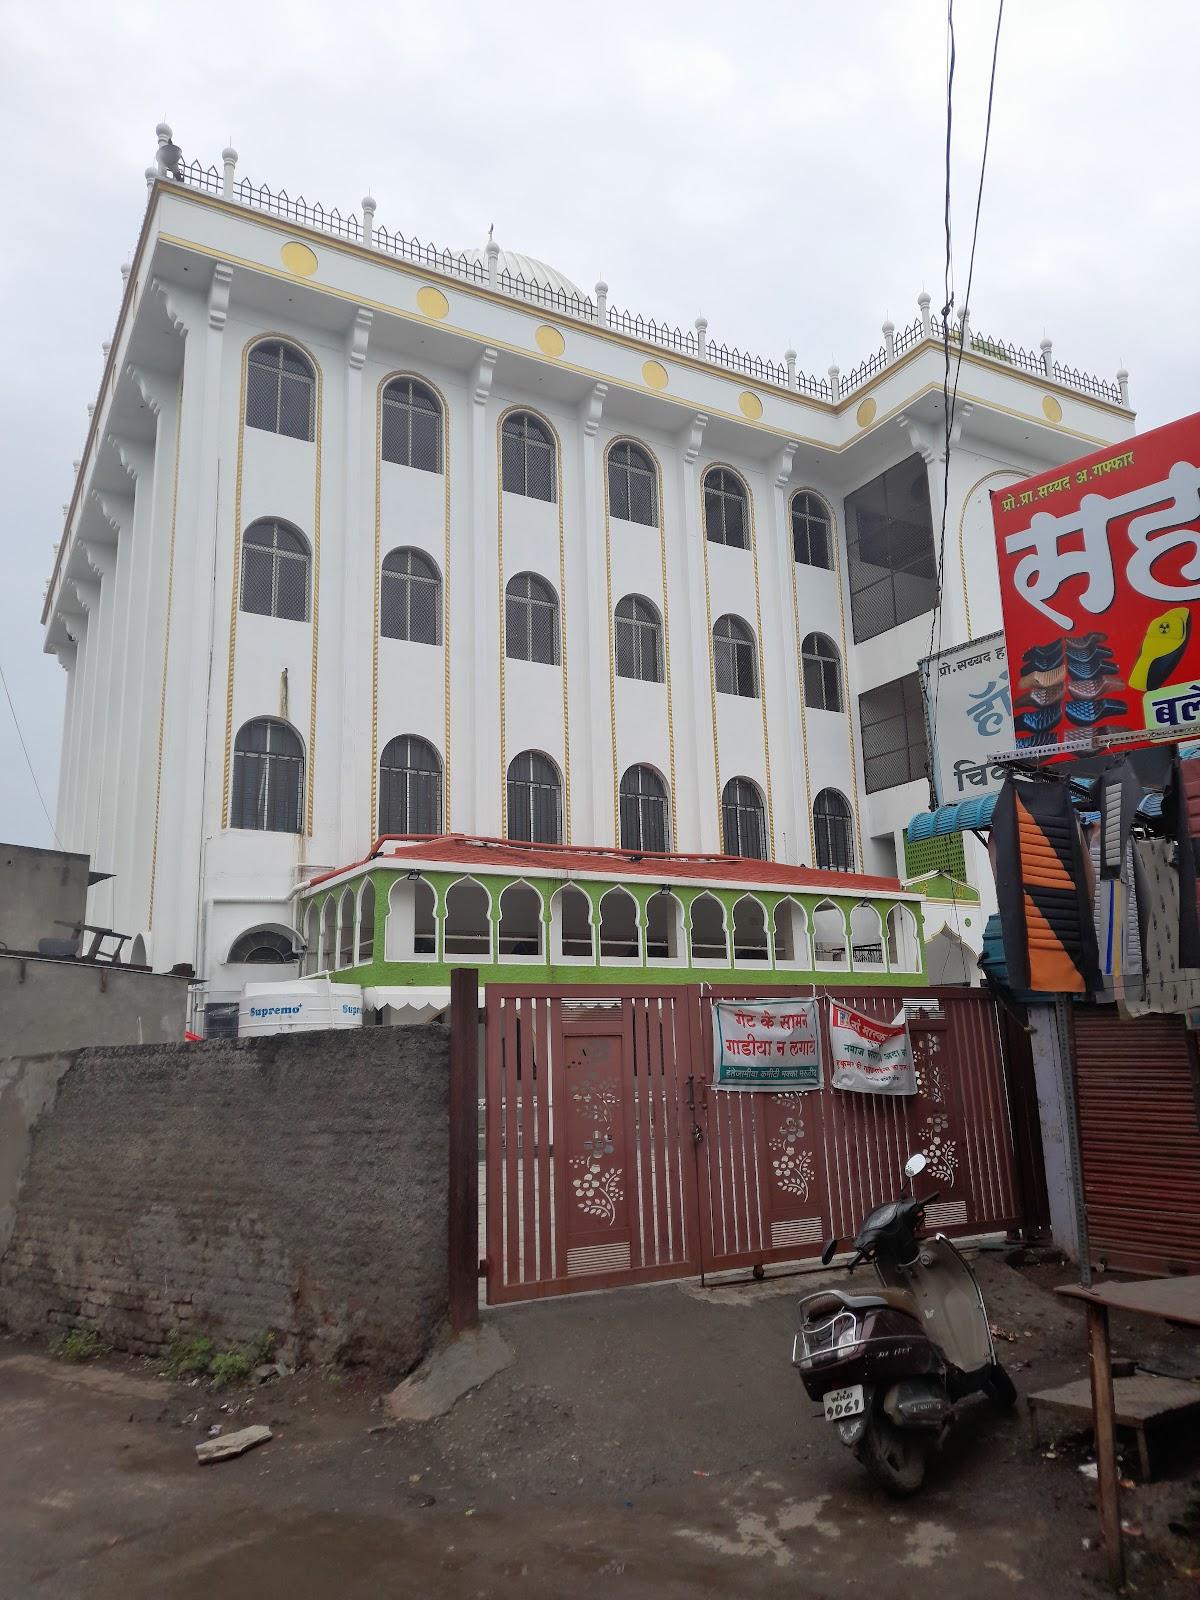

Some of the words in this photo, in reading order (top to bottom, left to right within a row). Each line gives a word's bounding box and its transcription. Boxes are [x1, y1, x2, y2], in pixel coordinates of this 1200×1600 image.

[735, 1010, 756, 1028] गेट
[760, 1010, 776, 1029] के
[780, 1008, 808, 1030] सामने
[725, 1033, 772, 1056] गाडीया
[776, 1041, 786, 1056] न
